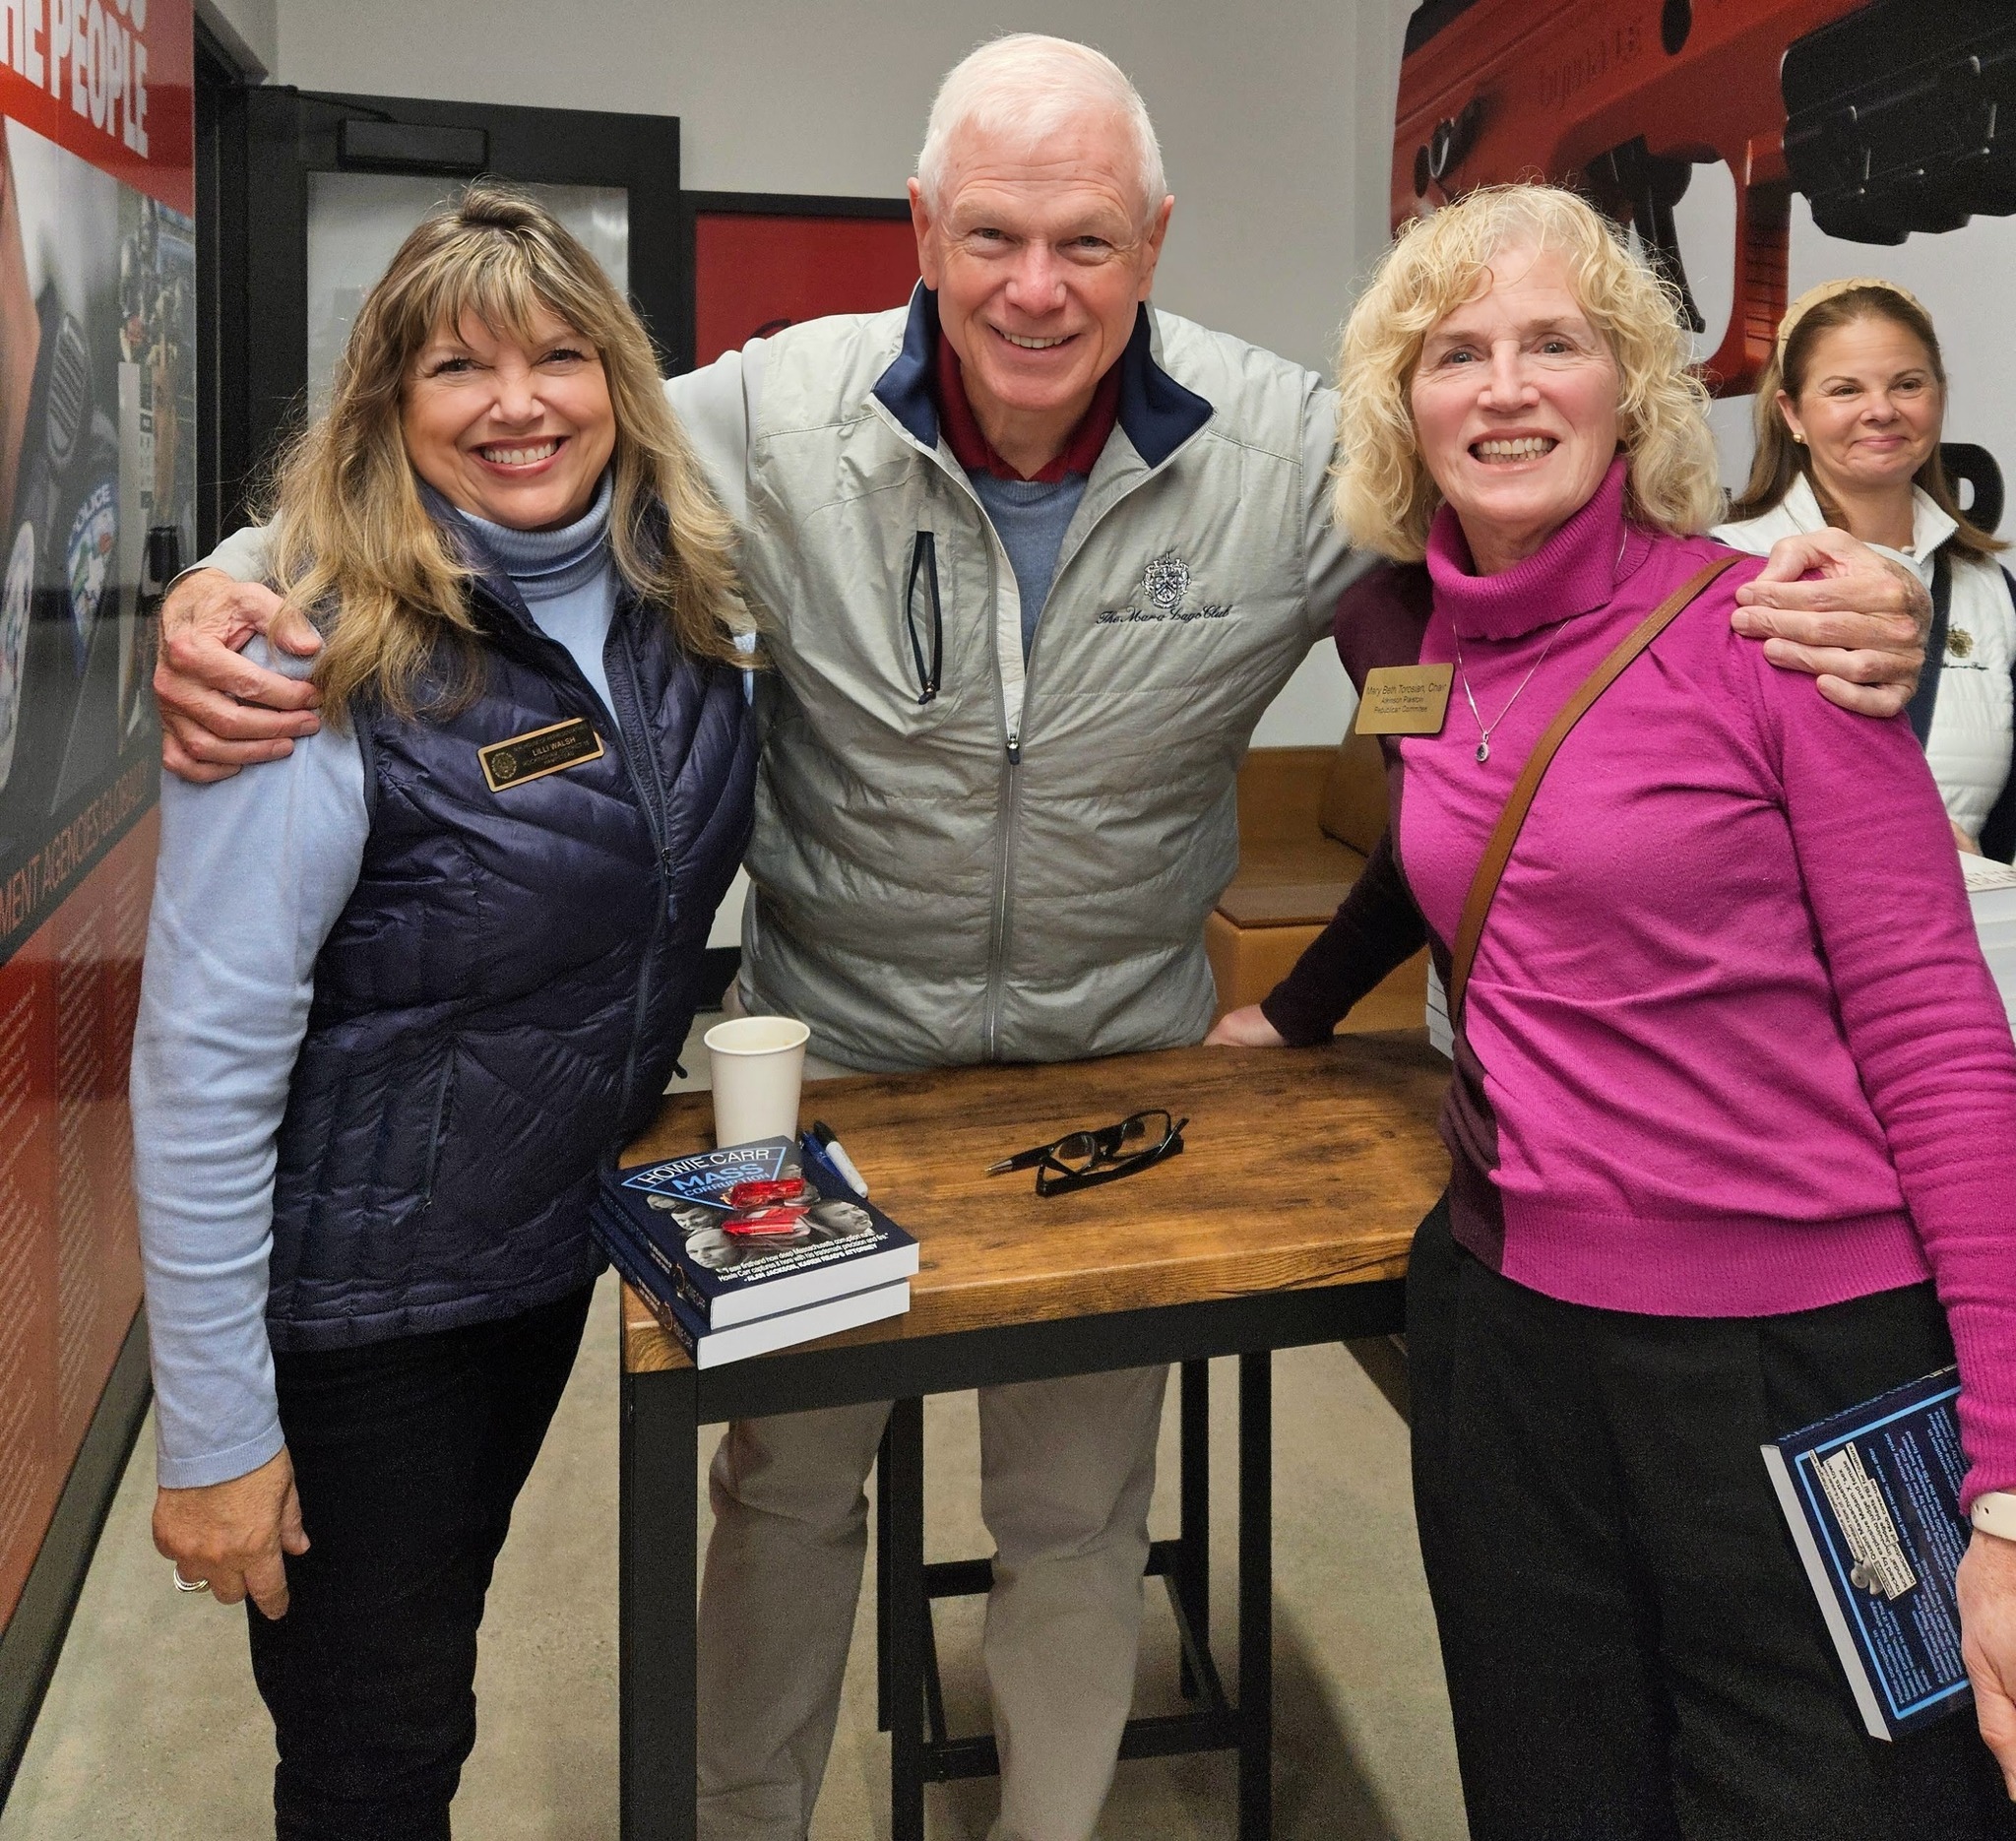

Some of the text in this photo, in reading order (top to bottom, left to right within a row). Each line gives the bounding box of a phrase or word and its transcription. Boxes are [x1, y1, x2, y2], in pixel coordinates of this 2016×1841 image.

[50, 0, 149, 159] PEOPLE
[1097, 611, 1120, 624] The
[1202, 603, 1233, 620] Club
[532, 745, 550, 757] LILLI
[550, 736, 577, 750] WALSH
[637, 1149, 770, 1184] HOWIE CARR
[671, 1163, 765, 1191] MASS
[683, 1173, 771, 1197] CORRUPTION
[1926, 1413, 1940, 1437] federal
[1884, 1432, 1895, 1451] ruled
[1905, 1430, 1919, 1454] forced
[1916, 1453, 1924, 1469] was
[1930, 1436, 1949, 1474] corruption
[1842, 1460, 1857, 1486] female
[1904, 1462, 1915, 1481] local
[1854, 1485, 1864, 1499] and
[1869, 1480, 1886, 1514] cover-ups
[1905, 1483, 1919, 1508] district
[1825, 1460, 1876, 1560] Quaint Massachusetts town
[1850, 1492, 1865, 1519] Madam
[1862, 1500, 1875, 1521] judge
[1870, 1498, 1881, 1520] blasts
[1891, 1505, 1902, 1523] tried
[1863, 1520, 1882, 1555] explosive
[1879, 1521, 1890, 1543] Judge
[1899, 1523, 1908, 1538] fact
[1906, 1538, 1912, 1547] in
[1880, 1555, 1888, 1566] by
[1909, 1547, 1918, 1562] was
[1885, 1566, 1901, 1593] rocked
[1927, 1574, 1936, 1590] first
[1869, 1601, 1882, 1626] always
[1876, 1600, 1885, 1616] has
[1913, 1594, 1922, 1610] was
[1884, 1621, 1893, 1636] but
[1912, 1610, 1925, 1637] woman
[1919, 1610, 1929, 1630] Read
[1927, 1630, 1939, 1654] Karen
[1876, 1638, 1895, 1678] corruption
[1922, 1637, 1939, 1672] innocent
[1886, 1643, 1911, 1700] Massachusetts
[1892, 1679, 1905, 1703] Police
